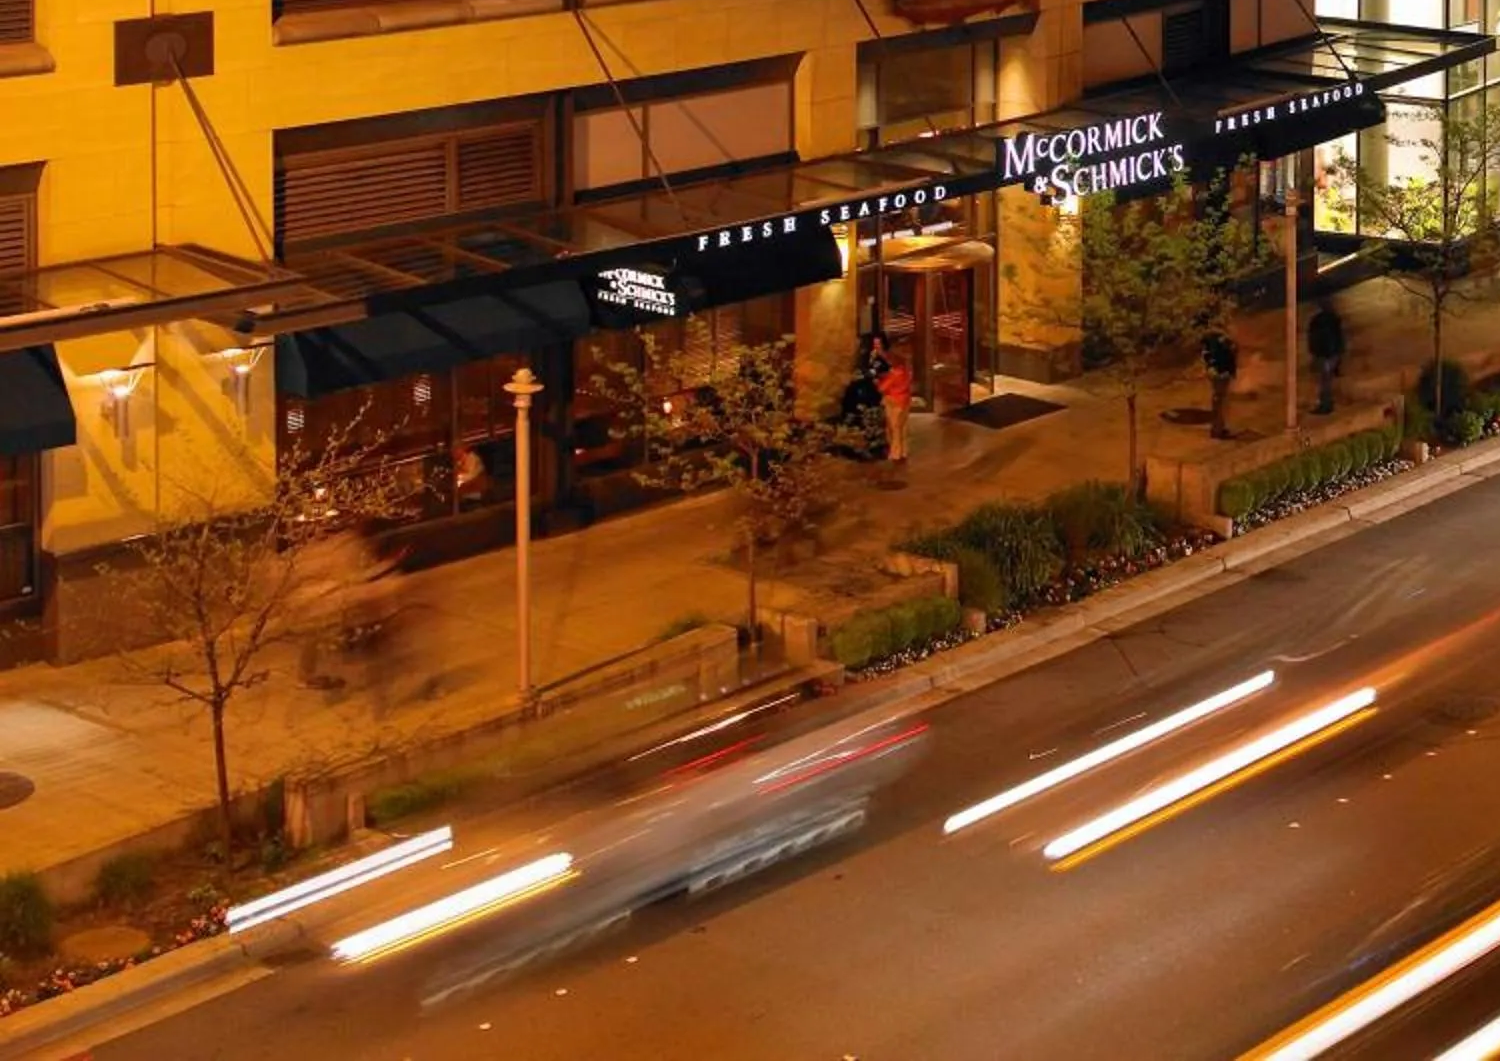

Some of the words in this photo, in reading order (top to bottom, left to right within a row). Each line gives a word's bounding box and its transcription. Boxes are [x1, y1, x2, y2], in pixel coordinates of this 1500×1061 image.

[1215, 106, 1275, 134] FRESH
[1289, 83, 1363, 114] SEAFOOD
[1034, 176, 1048, 194] &
[1051, 144, 1185, 206] SCHMICK'S
[697, 216, 797, 252] FRESH
[820, 186, 947, 225] SEAFOOD
